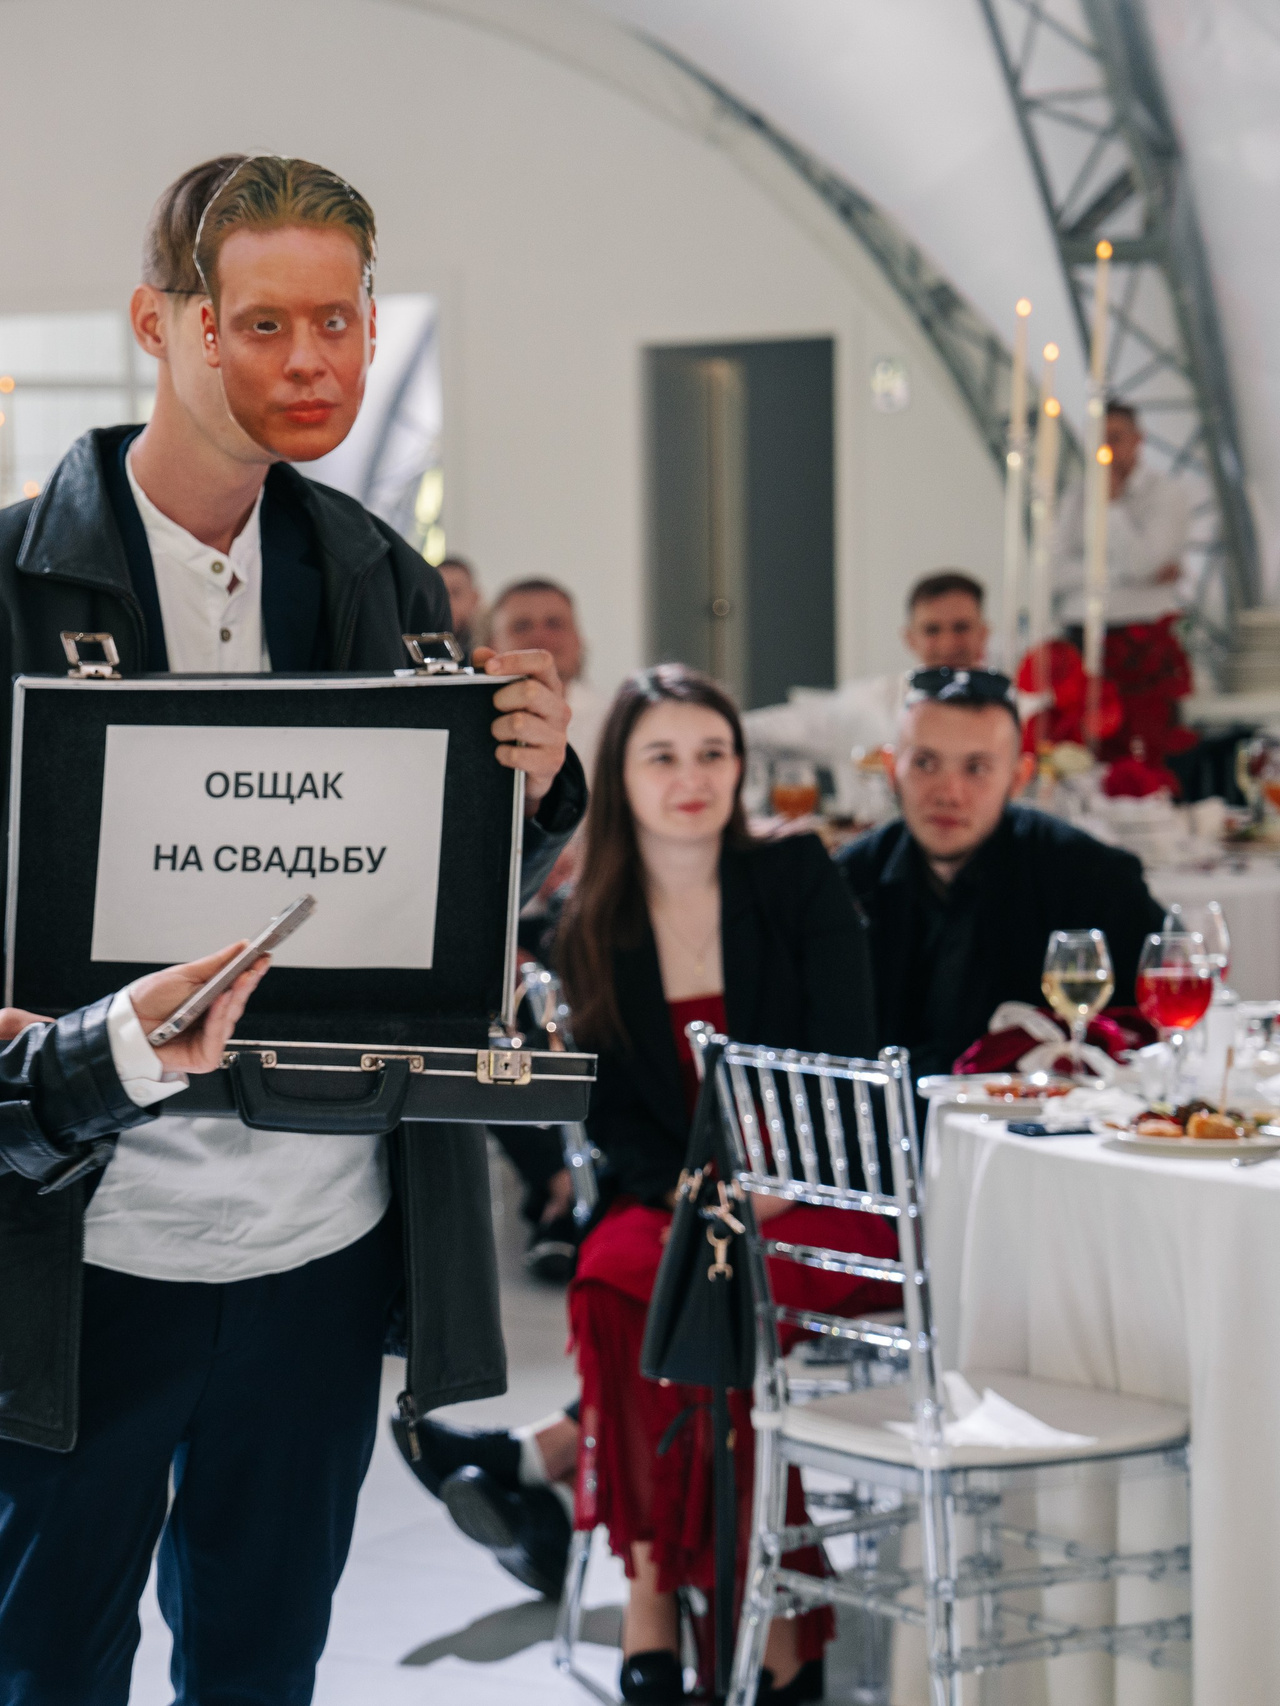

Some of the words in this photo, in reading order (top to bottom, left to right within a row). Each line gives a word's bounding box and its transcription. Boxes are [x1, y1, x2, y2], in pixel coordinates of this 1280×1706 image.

[204, 771, 344, 805] ОБЩАК
[152, 844, 204, 872] НА
[213, 845, 388, 879] СВАДЬБУ
